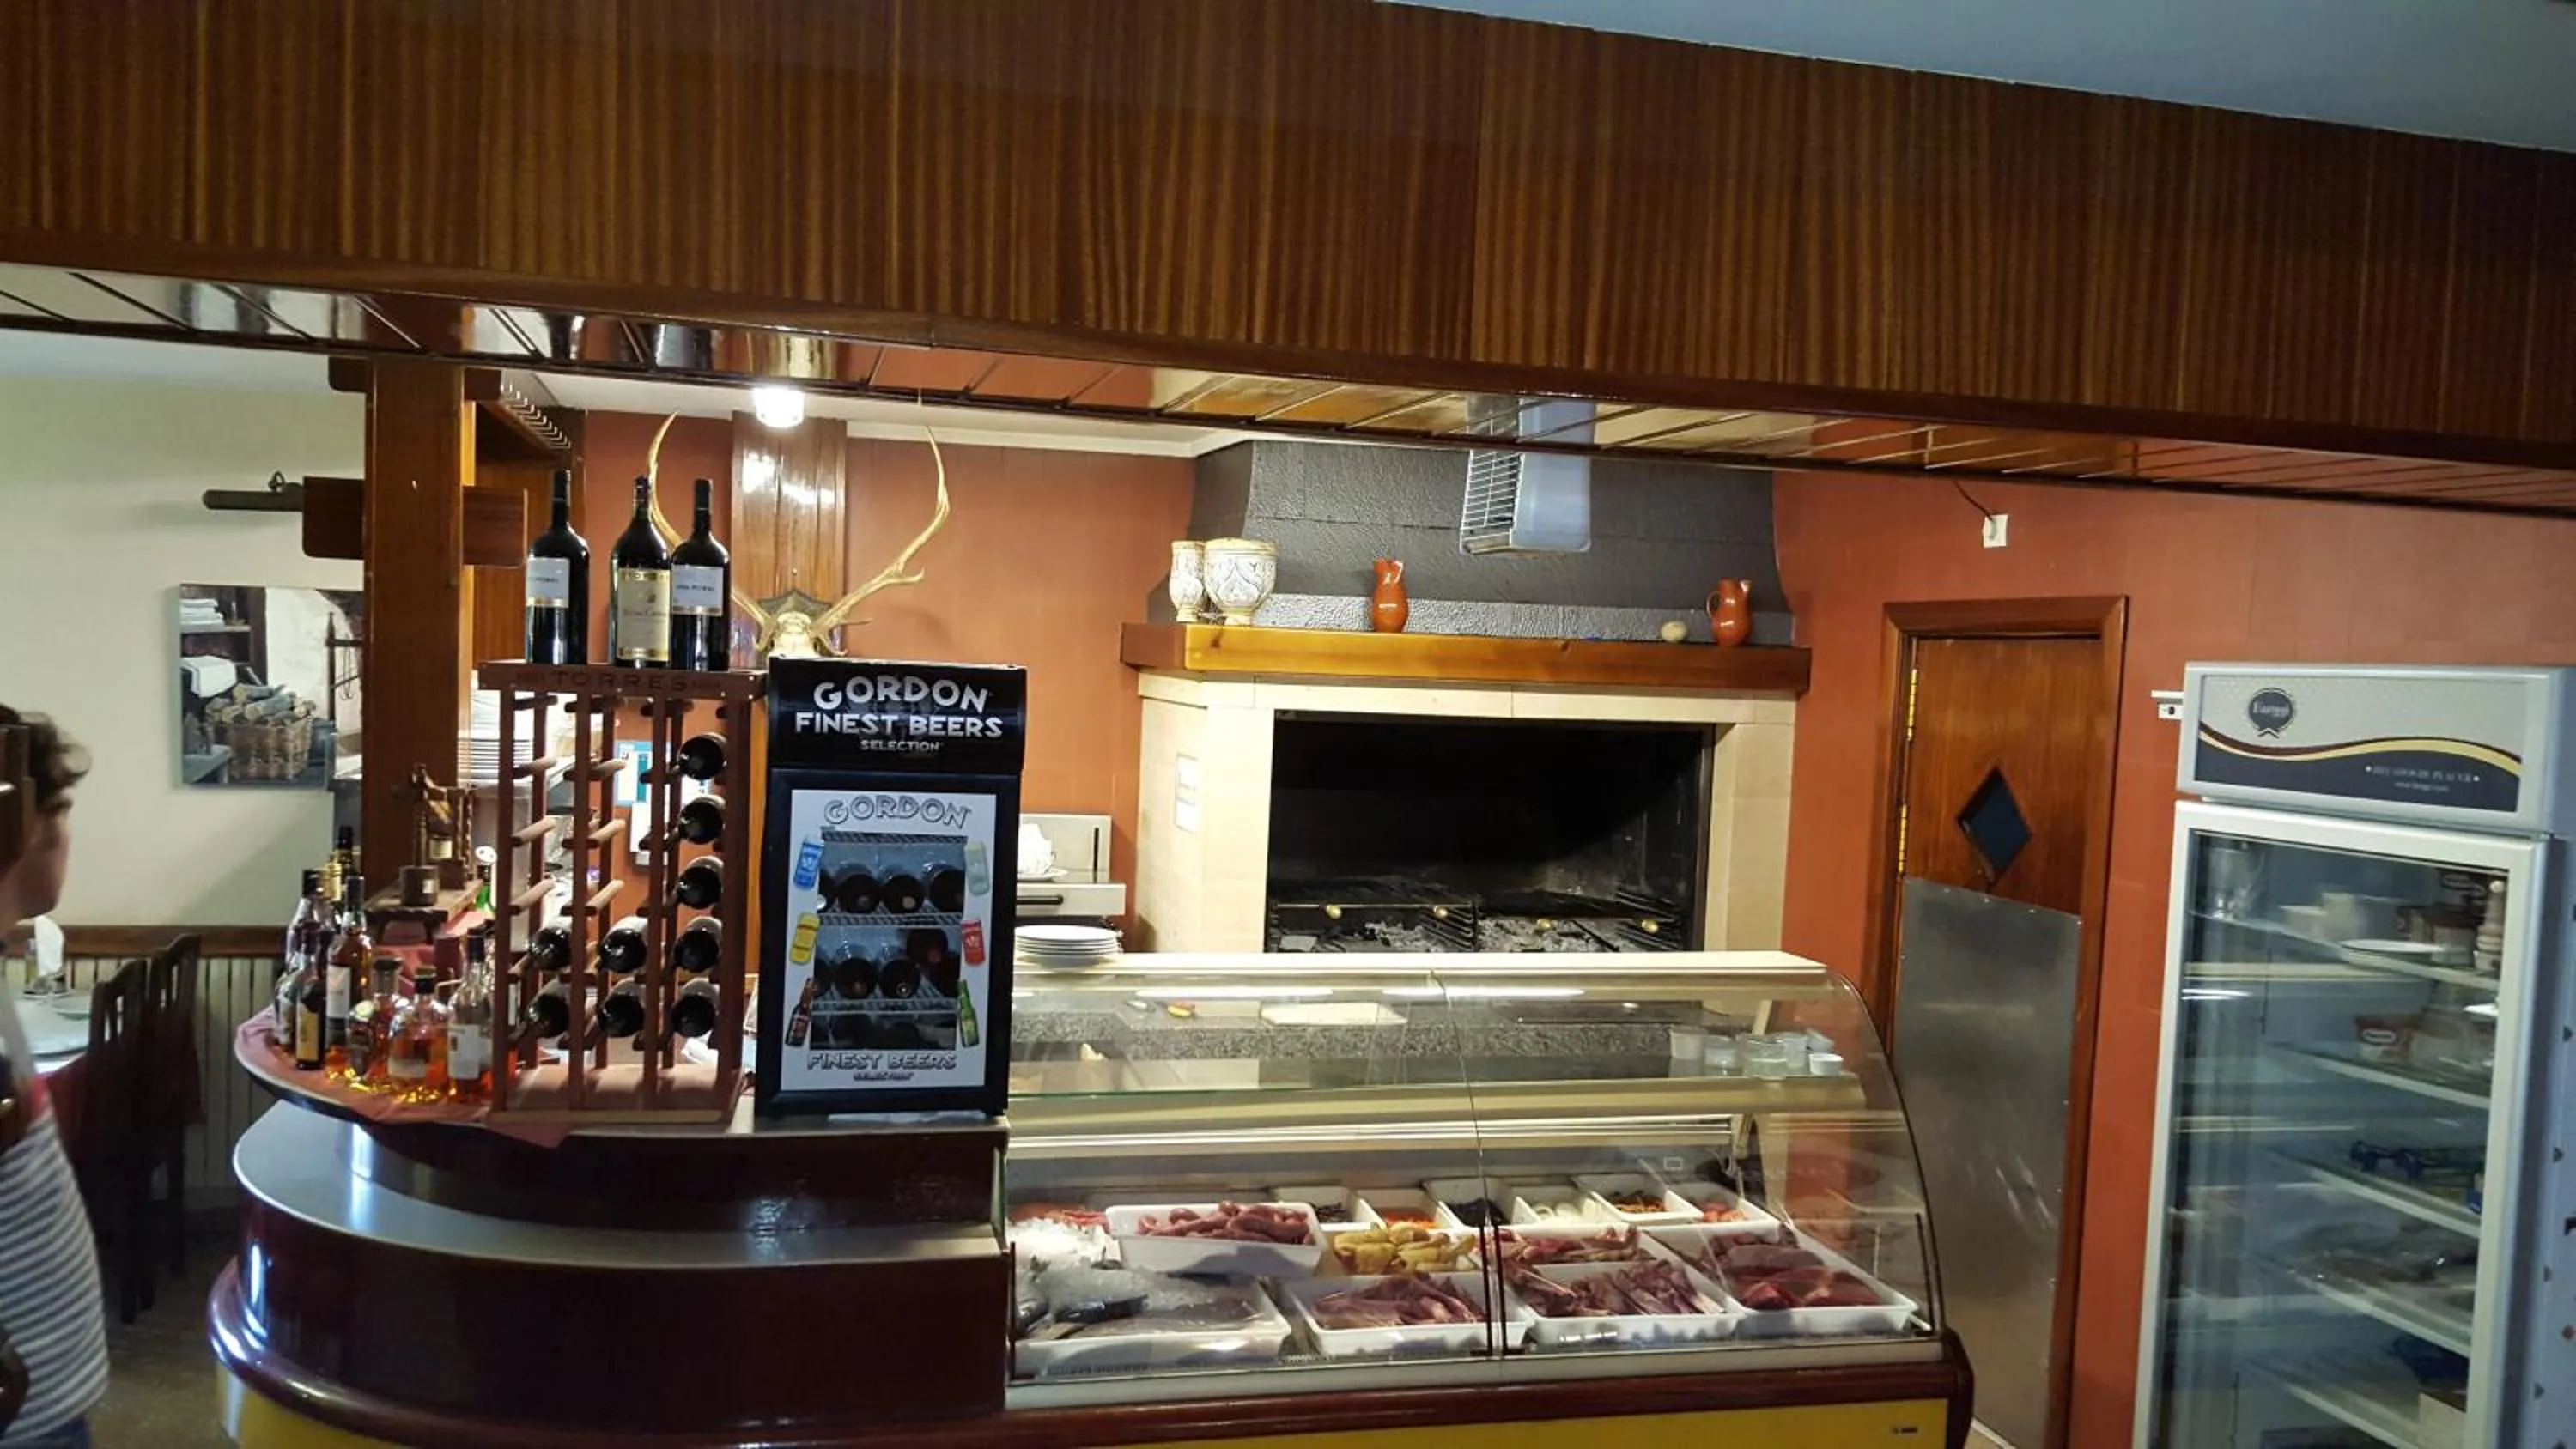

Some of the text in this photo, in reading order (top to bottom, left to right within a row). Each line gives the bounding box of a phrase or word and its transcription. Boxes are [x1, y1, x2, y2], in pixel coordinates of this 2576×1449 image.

[551, 670, 688, 690] TORRES
[813, 675, 989, 713] GORDON
[795, 712, 1004, 738] FINEST BEERS
[860, 738, 940, 752] SELECTION
[823, 795, 971, 830] GORDON
[807, 1052, 957, 1070] FINEST BEERS
